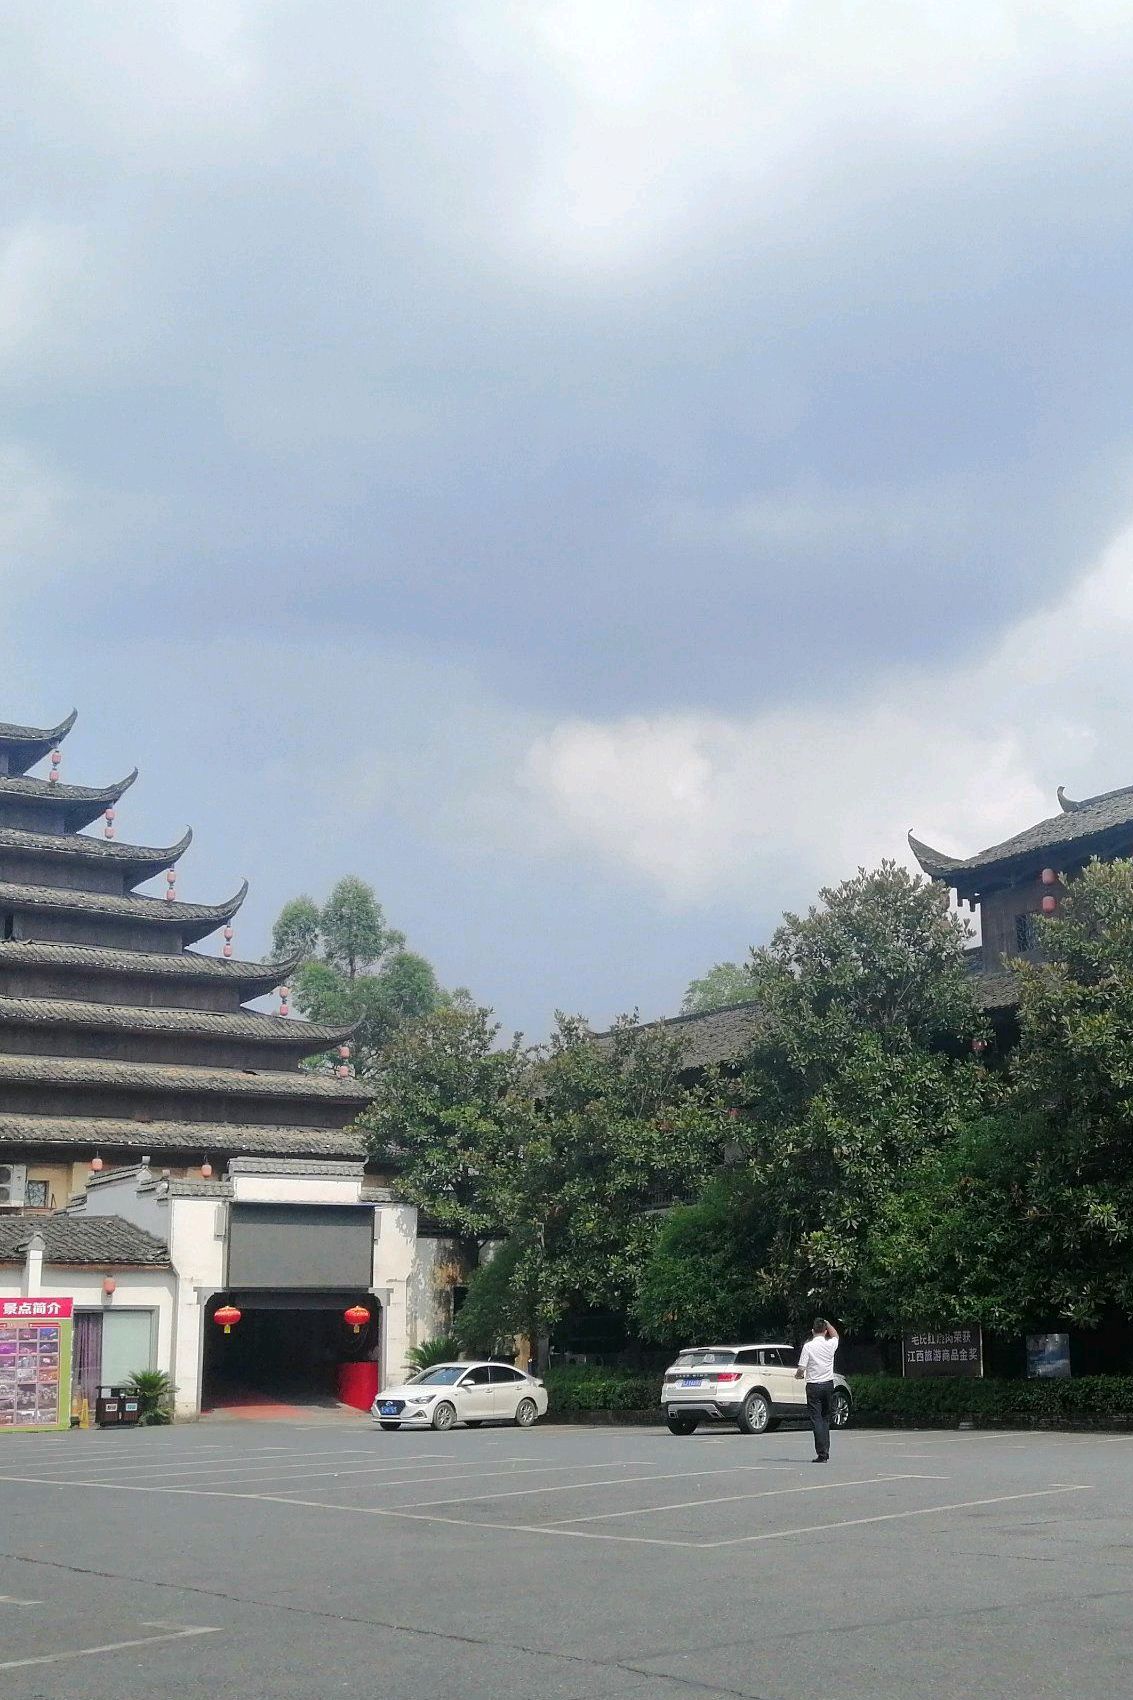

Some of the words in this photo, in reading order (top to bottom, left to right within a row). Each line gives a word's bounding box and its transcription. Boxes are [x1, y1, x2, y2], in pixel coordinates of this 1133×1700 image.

[2, 1301, 62, 1315] 景点简介
[907, 1347, 978, 1362] 江西旅游商品金奖
